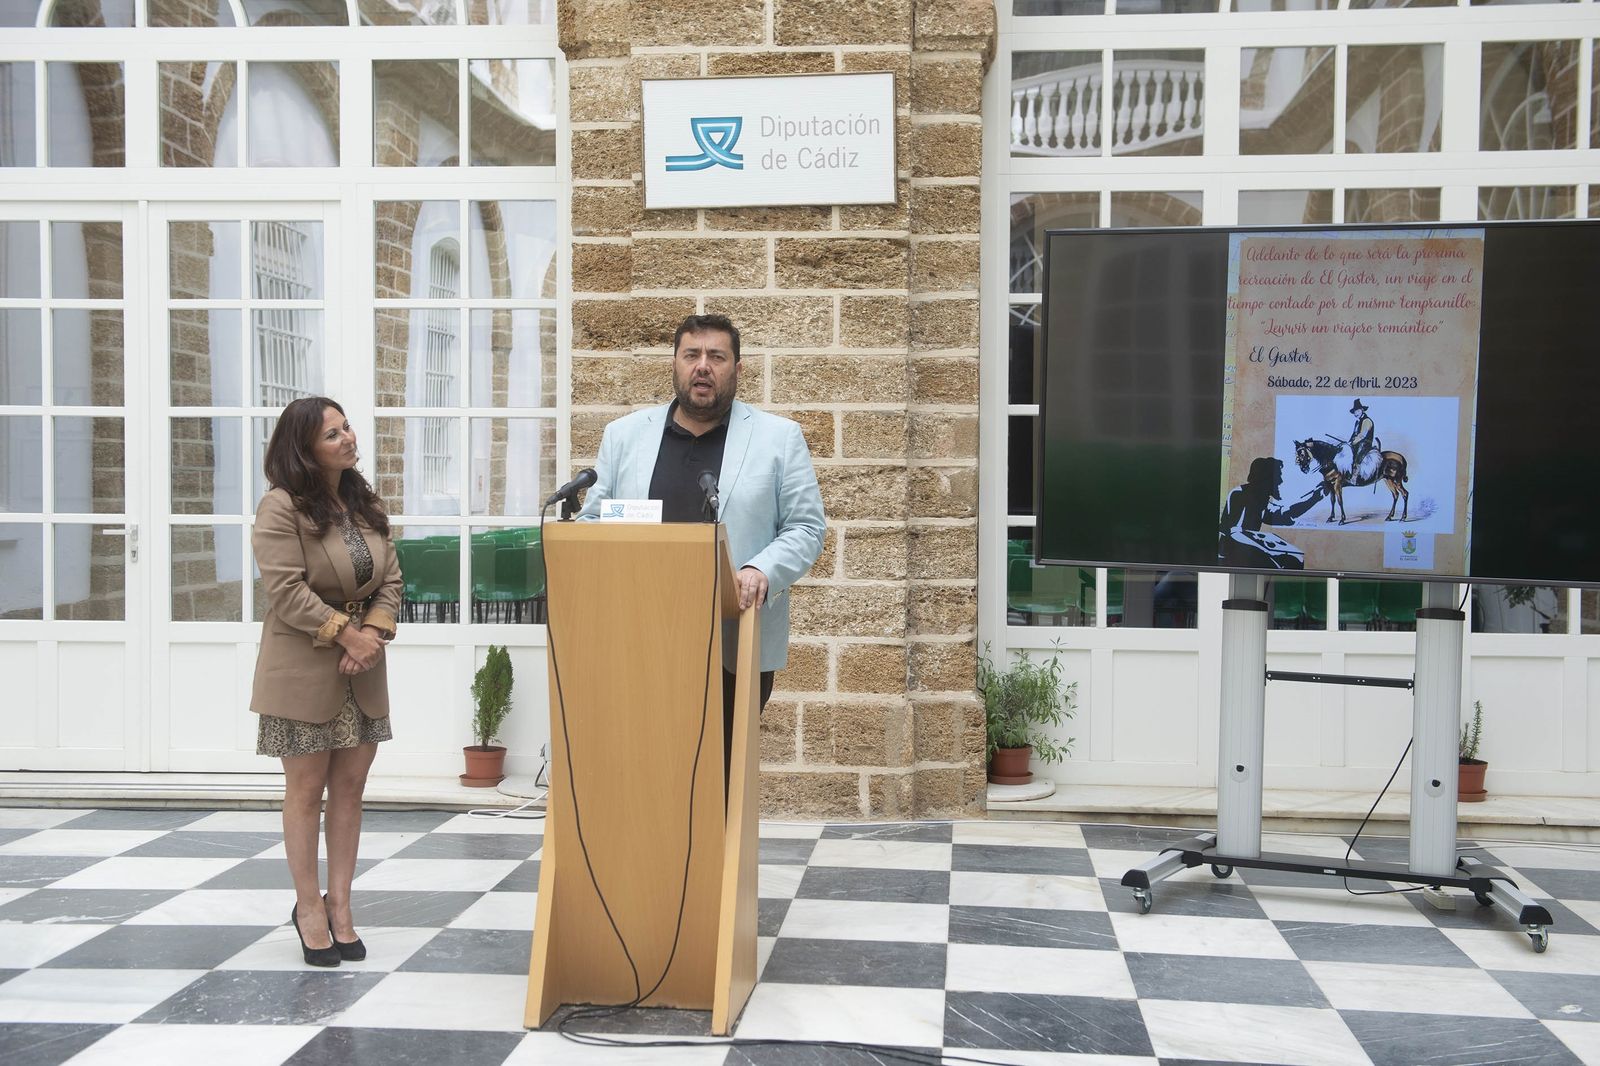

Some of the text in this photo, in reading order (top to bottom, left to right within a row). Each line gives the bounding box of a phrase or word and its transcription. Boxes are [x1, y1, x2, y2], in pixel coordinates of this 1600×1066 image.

[761, 113, 880, 141] Diputación
[761, 146, 859, 170] de Cádiz
[1247, 246, 1299, 261] Adelanto
[1305, 246, 1318, 260] de
[1323, 245, 1336, 260] lo
[1340, 251, 1361, 265] que
[1366, 247, 1391, 260] será
[1396, 244, 1410, 260] la
[1238, 268, 1473, 291] recreación de El Gastor, un viaje en el
[1226, 296, 1264, 316] tiempo
[1268, 295, 1314, 309] contado
[1317, 299, 1338, 316] por
[1342, 295, 1353, 309] el
[1357, 298, 1395, 309] mismo
[1312, 326, 1329, 334] un
[1333, 322, 1372, 340] viajero
[1249, 345, 1312, 367] El Gastor
[1267, 375, 1312, 390] Sábado,
[1315, 376, 1331, 389] 22
[1334, 376, 1347, 389] de
[1385, 376, 1418, 389] 2023
